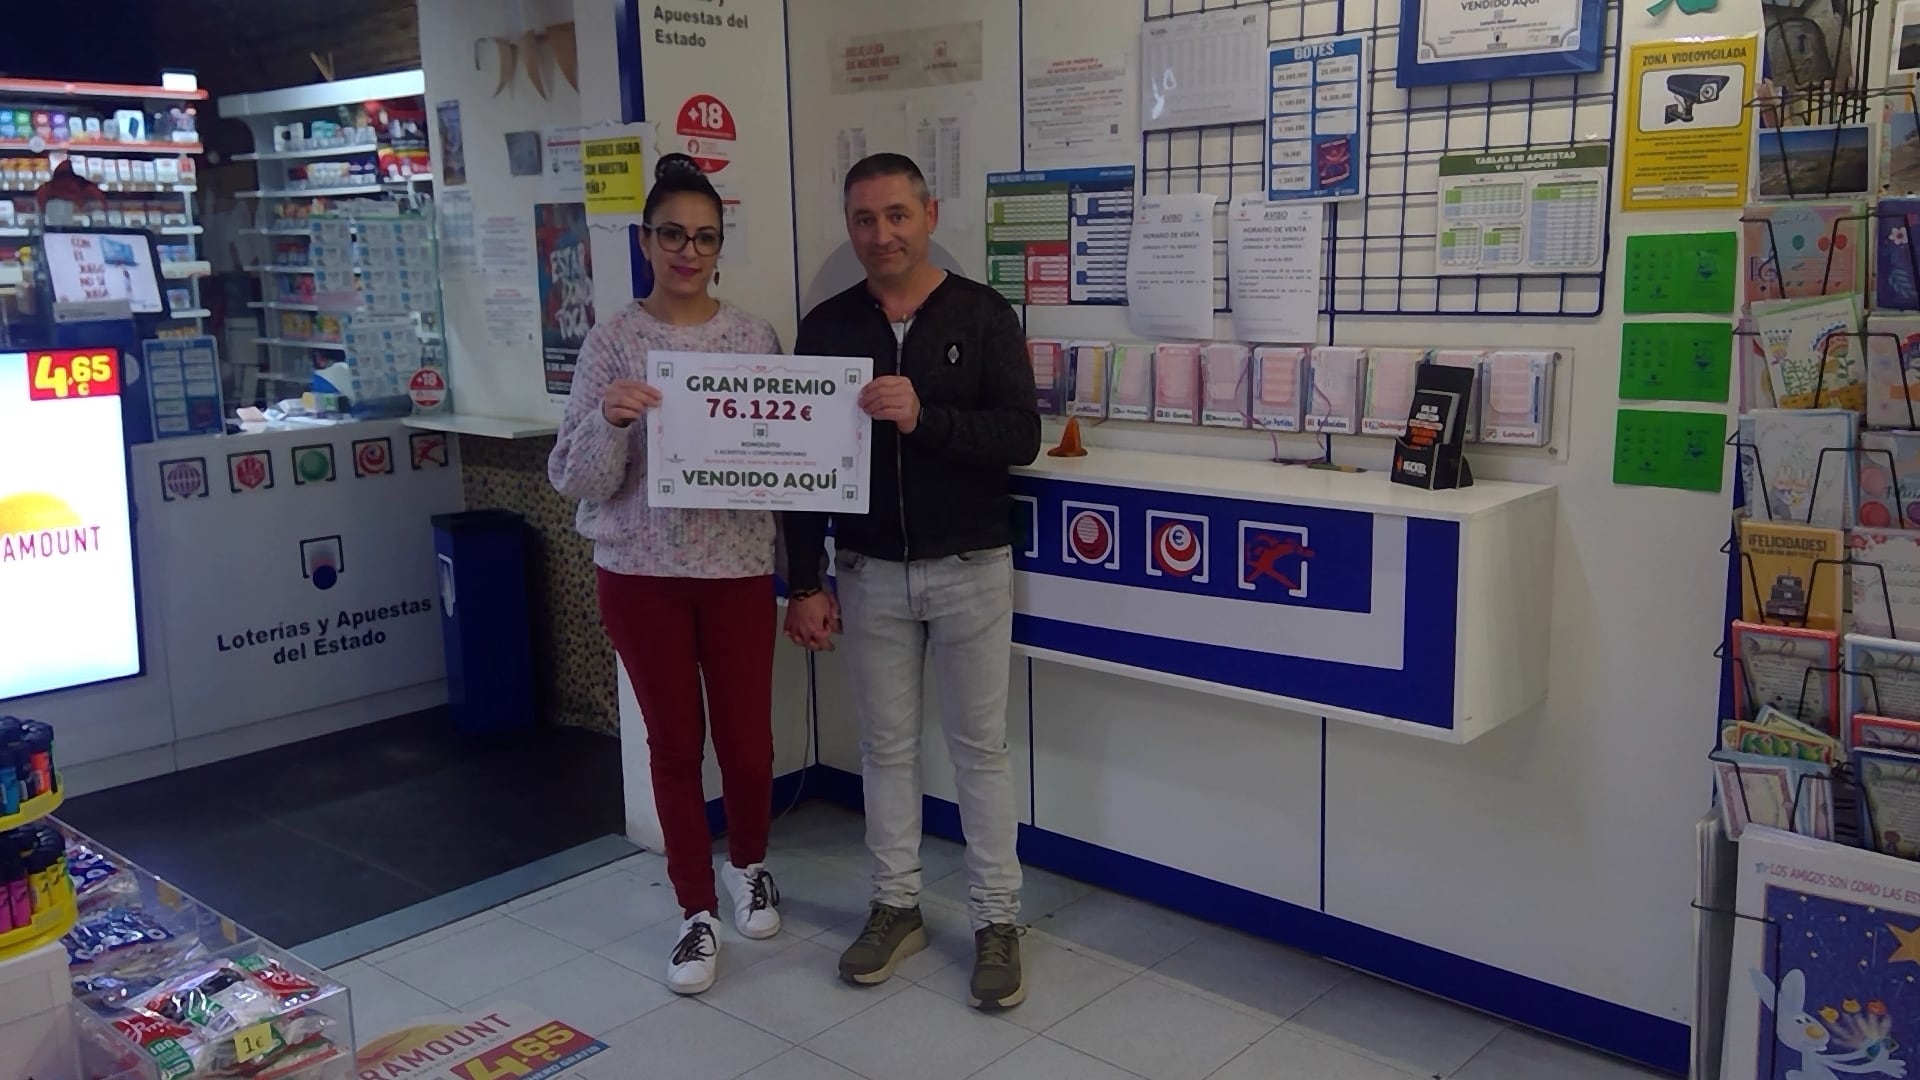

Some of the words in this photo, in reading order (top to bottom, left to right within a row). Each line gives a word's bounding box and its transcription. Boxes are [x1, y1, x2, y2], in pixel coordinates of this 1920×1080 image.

[1461, 0, 1511, 11] VENDIDO
[654, 5, 722, 27] Apuestas
[727, 12, 749, 29] del
[655, 28, 706, 48] Estado
[1294, 42, 1335, 60] BOTES
[1642, 53, 1667, 66] ZONA
[1672, 47, 1747, 63] VIDEOVIGILADA
[688, 101, 724, 130] +18
[1475, 156, 1510, 165] TABLAS
[1512, 154, 1525, 162] DE
[1527, 151, 1577, 161] APUESTAS
[1518, 161, 1558, 170] IMPORTE
[1161, 213, 1183, 222] AVISO
[1264, 210, 1288, 219] AVISO
[1142, 231, 1169, 239] HORARIO
[1285, 225, 1307, 233] VENTA
[34, 354, 112, 398] 4,65
[686, 375, 748, 393] GRAN
[753, 377, 836, 396] PREMIO
[682, 470, 779, 488] VENDIDO
[784, 468, 837, 491] AQUÍ
[216, 621, 311, 651] Loterías
[317, 618, 330, 636] y
[336, 598, 433, 629] Apuestas
[273, 643, 307, 665] del
[314, 629, 386, 656] Estado
[1770, 863, 1787, 878] LOS
[1790, 868, 1826, 886] AMIGOS
[1828, 876, 1848, 889] SON
[1851, 880, 1880, 897] COMO
[1882, 887, 1901, 901] LAS
[561, 1045, 601, 1067] GRATIS
